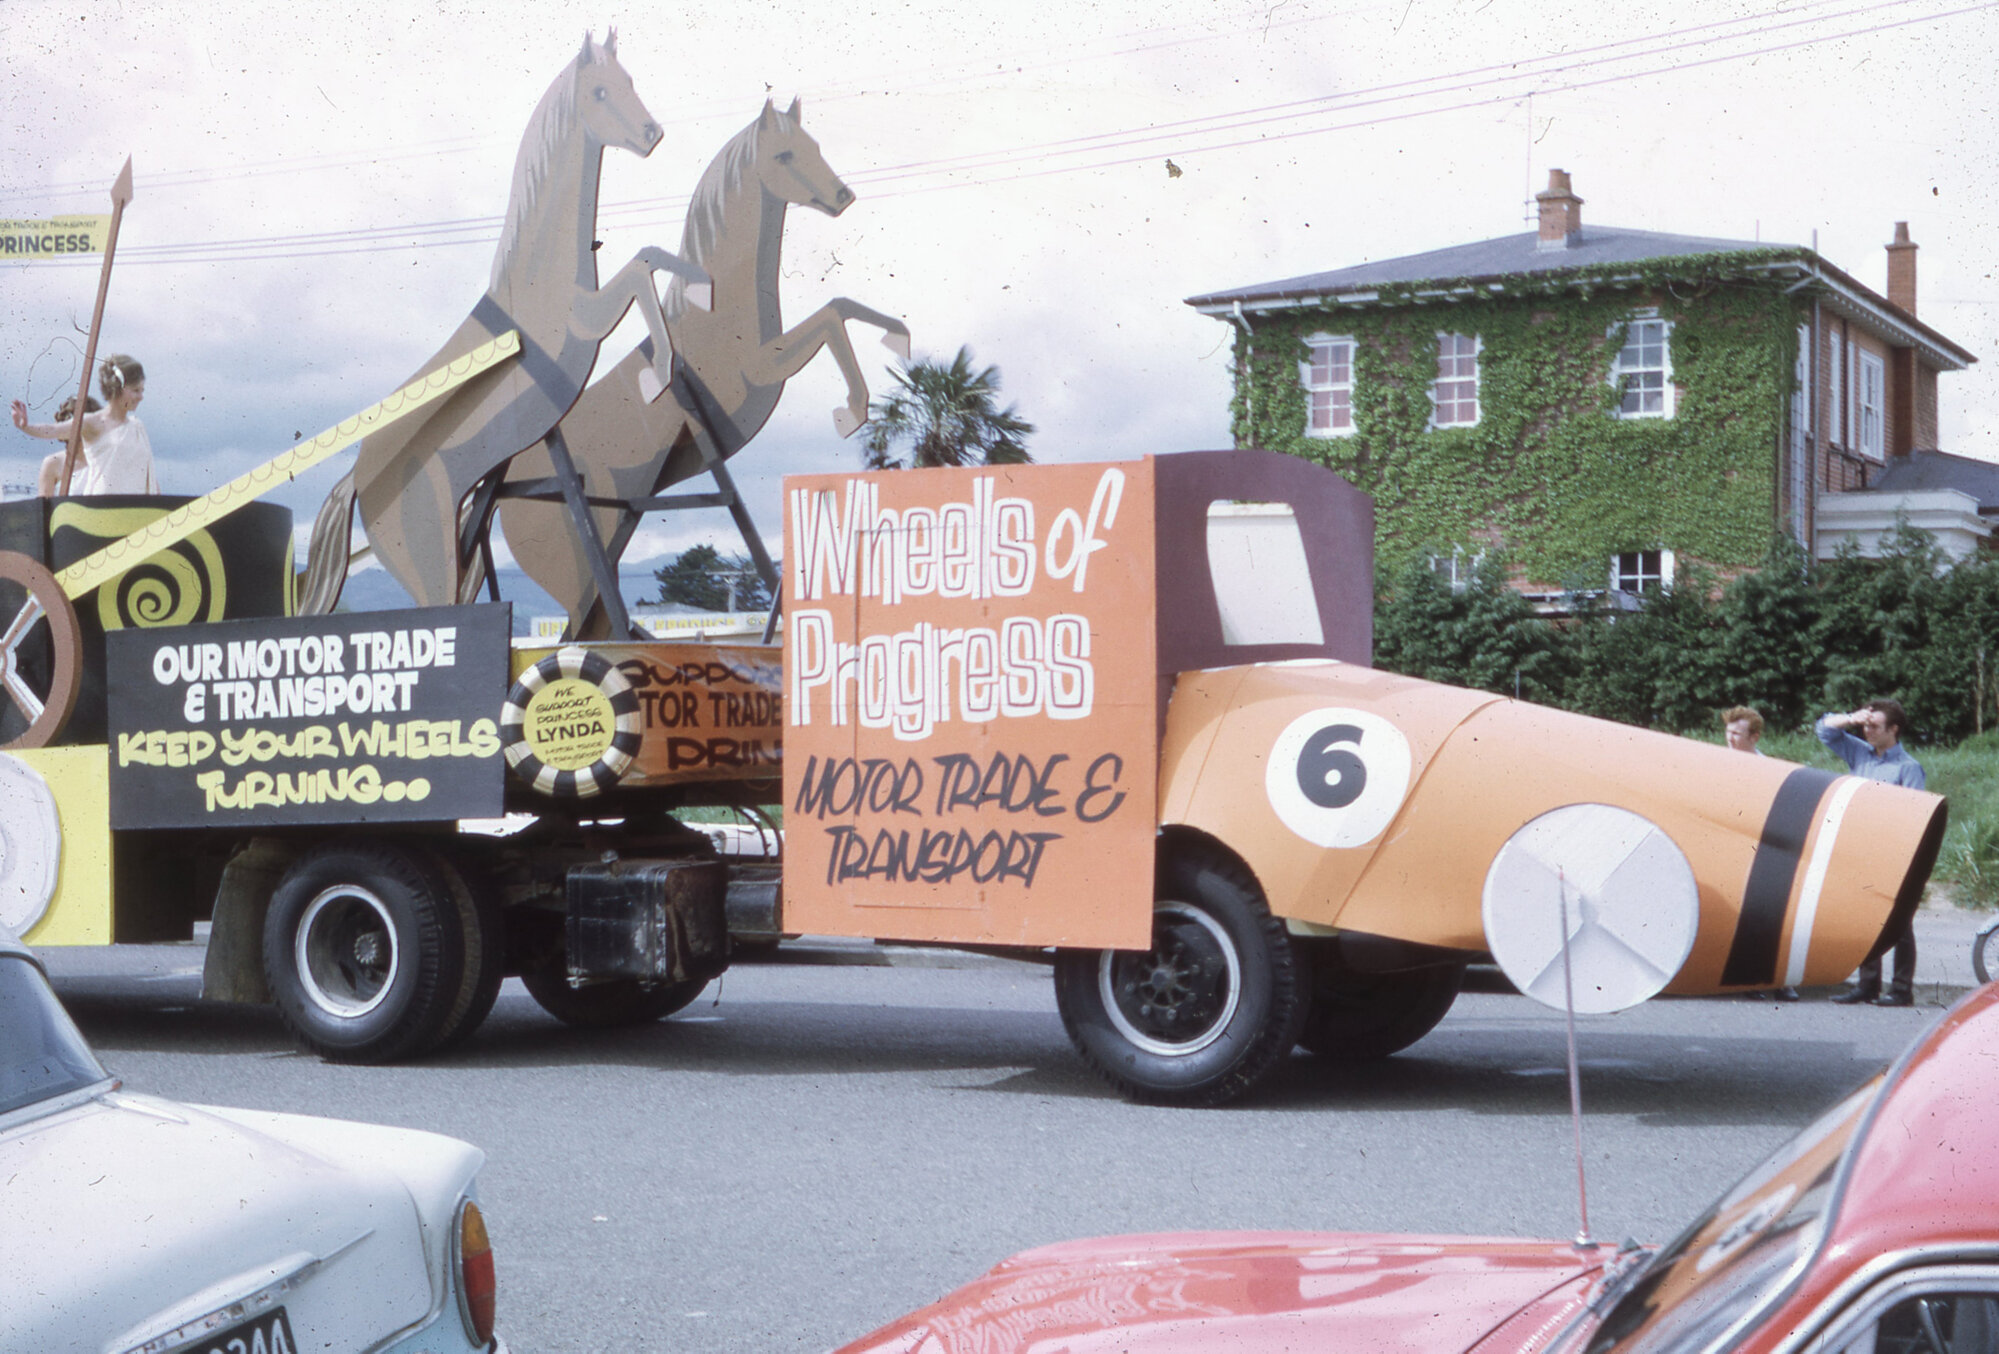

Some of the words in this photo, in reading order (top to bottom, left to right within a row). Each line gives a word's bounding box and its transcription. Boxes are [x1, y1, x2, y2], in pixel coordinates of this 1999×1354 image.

[790, 476, 1036, 605] Wheels
[1045, 467, 1125, 593] of
[153, 643, 224, 685] OUR
[227, 635, 344, 680] MOTOR
[350, 627, 457, 671] TRADE
[791, 608, 1095, 742] Progress
[213, 671, 419, 721] TRANSPORT
[535, 695, 594, 713] SUPPORT
[536, 707, 602, 724] PRINCESS
[554, 685, 576, 698] WE
[708, 691, 783, 727] TRADE
[118, 730, 216, 767] KEEP
[220, 725, 339, 766] YOUR
[338, 718, 501, 760] WHEELS
[536, 721, 605, 743] LYNDA
[794, 754, 924, 820] MOTOR
[933, 751, 1070, 817] TRADE
[1075, 752, 1126, 823] &
[1296, 724, 1367, 809] 6
[824, 824, 1066, 889] TRANSPORT
